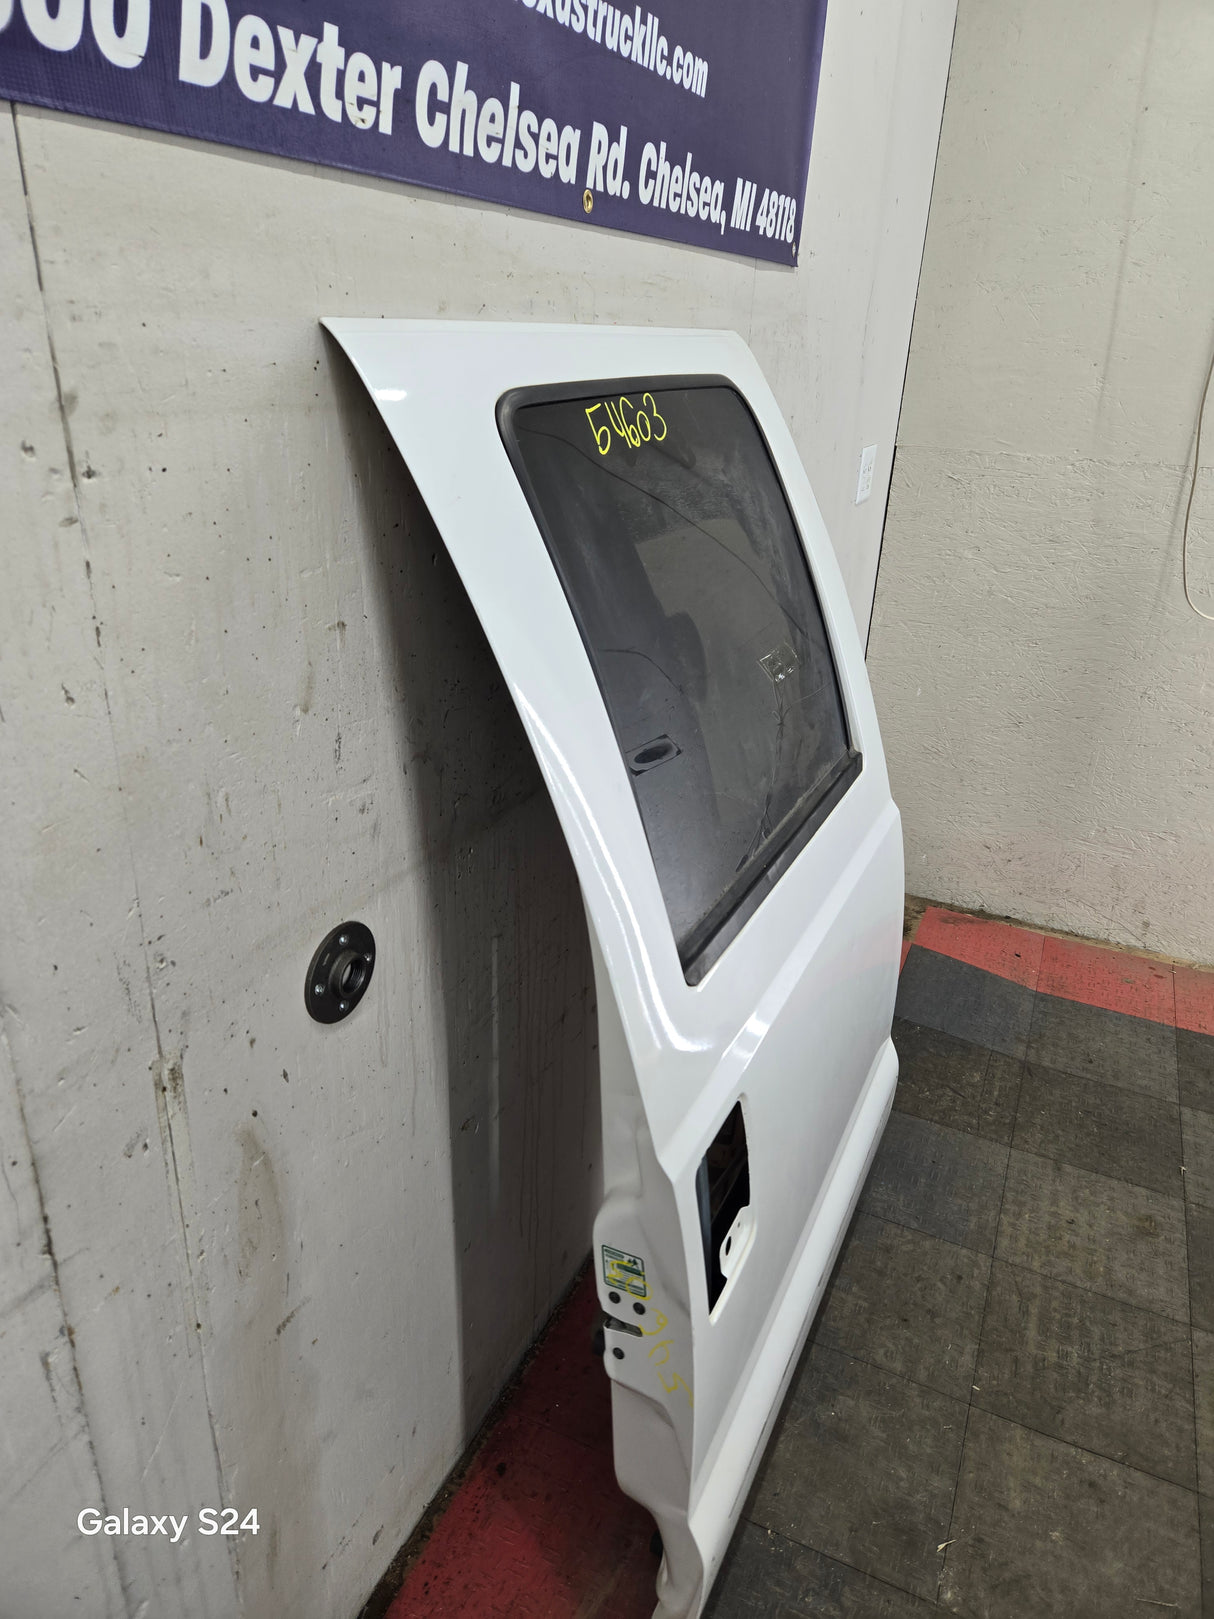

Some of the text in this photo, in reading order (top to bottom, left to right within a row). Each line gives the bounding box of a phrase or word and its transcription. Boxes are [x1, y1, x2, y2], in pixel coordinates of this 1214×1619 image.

[179, 0, 402, 136] Dexter
[415, 59, 581, 185] Chelsea
[586, 121, 630, 199] Rd.
[639, 141, 726, 235] Chelsea,
[730, 177, 757, 232] MI
[756, 188, 796, 243] 48118
[585, 392, 667, 455] 54603
